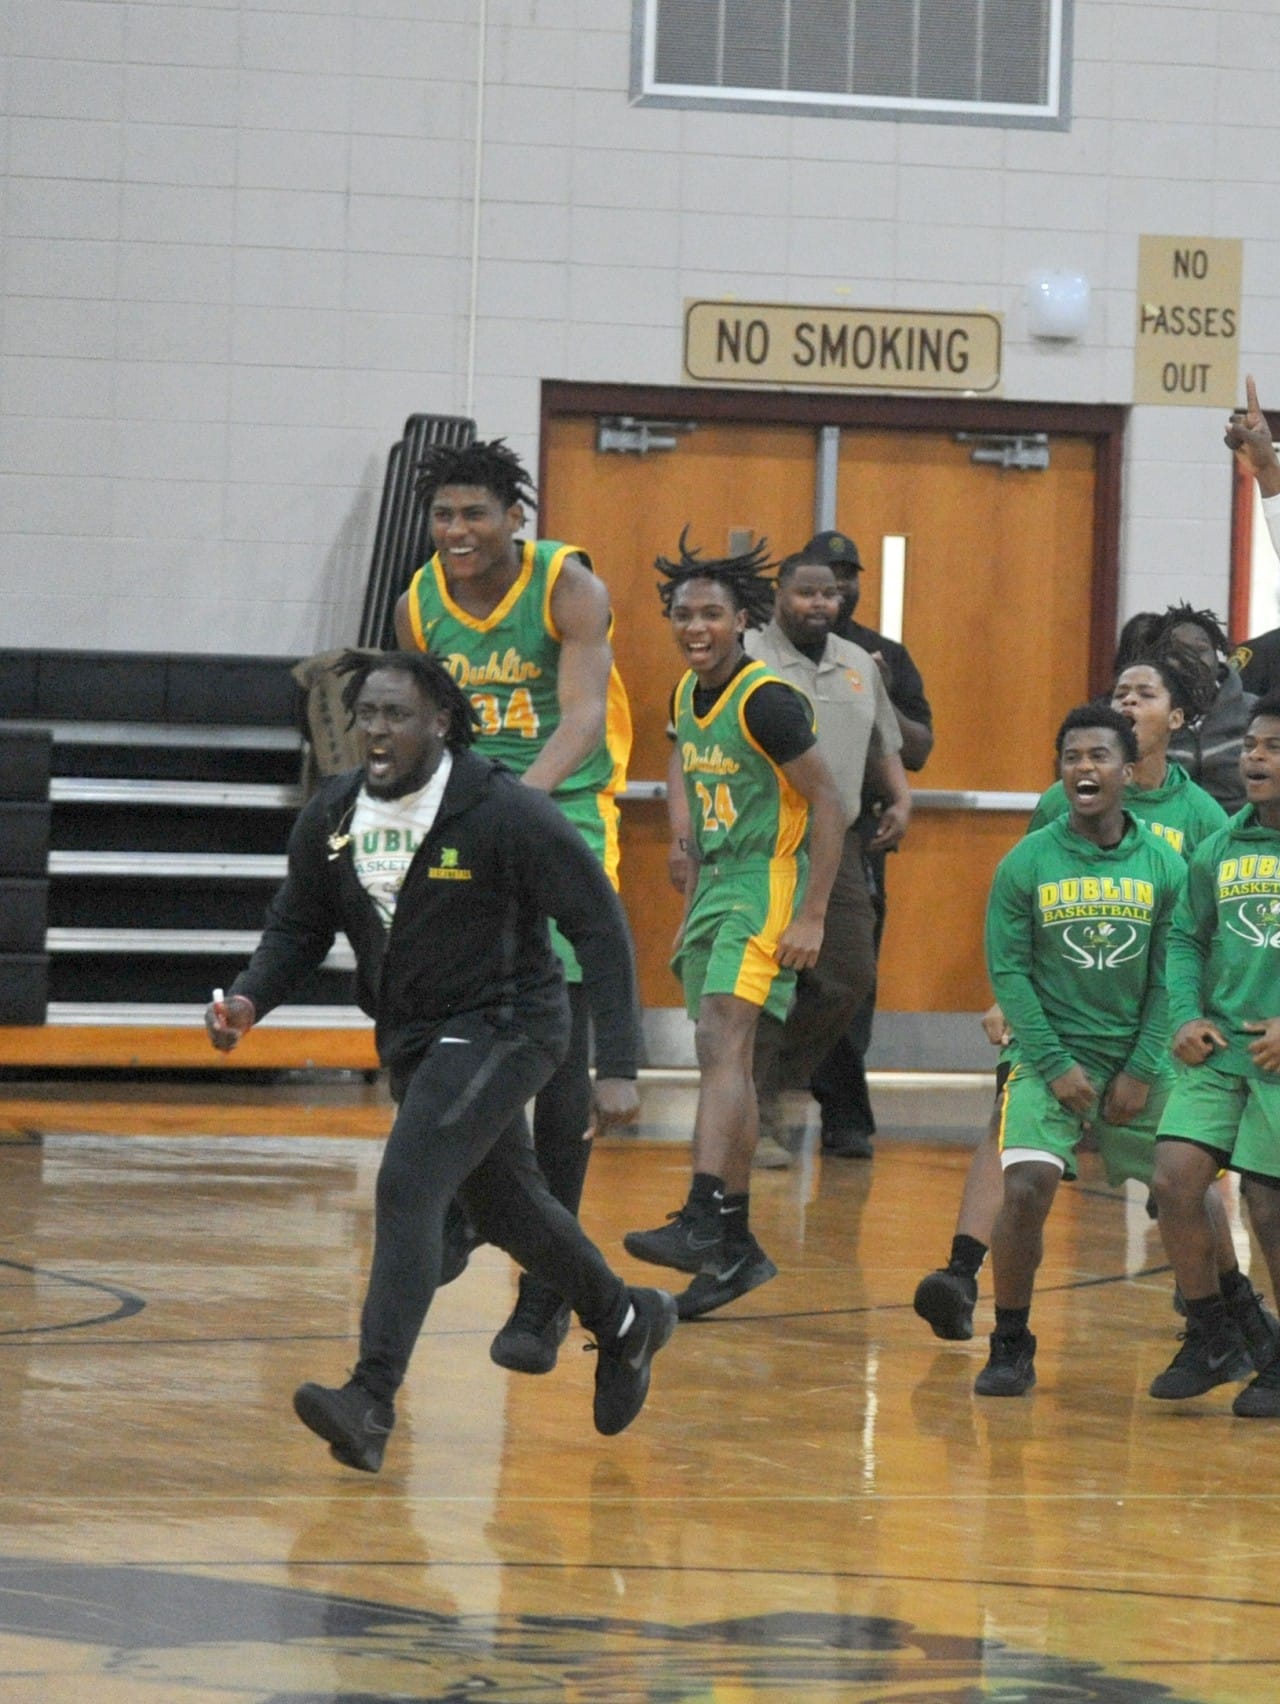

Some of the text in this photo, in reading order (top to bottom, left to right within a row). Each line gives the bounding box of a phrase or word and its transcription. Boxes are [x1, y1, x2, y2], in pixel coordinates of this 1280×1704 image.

[1174, 249, 1208, 279] NO
[1140, 304, 1236, 338] PASSES
[716, 319, 969, 374] NO SMOKING
[1162, 362, 1212, 393] OUT
[442, 647, 541, 689] Dublin
[469, 688, 540, 739] 34
[695, 781, 739, 832] 24
[352, 829, 420, 857] UBL
[356, 860, 410, 875] ASKET
[1038, 877, 1155, 911] DUBLIN
[1043, 904, 1153, 922] BASKETBALL
